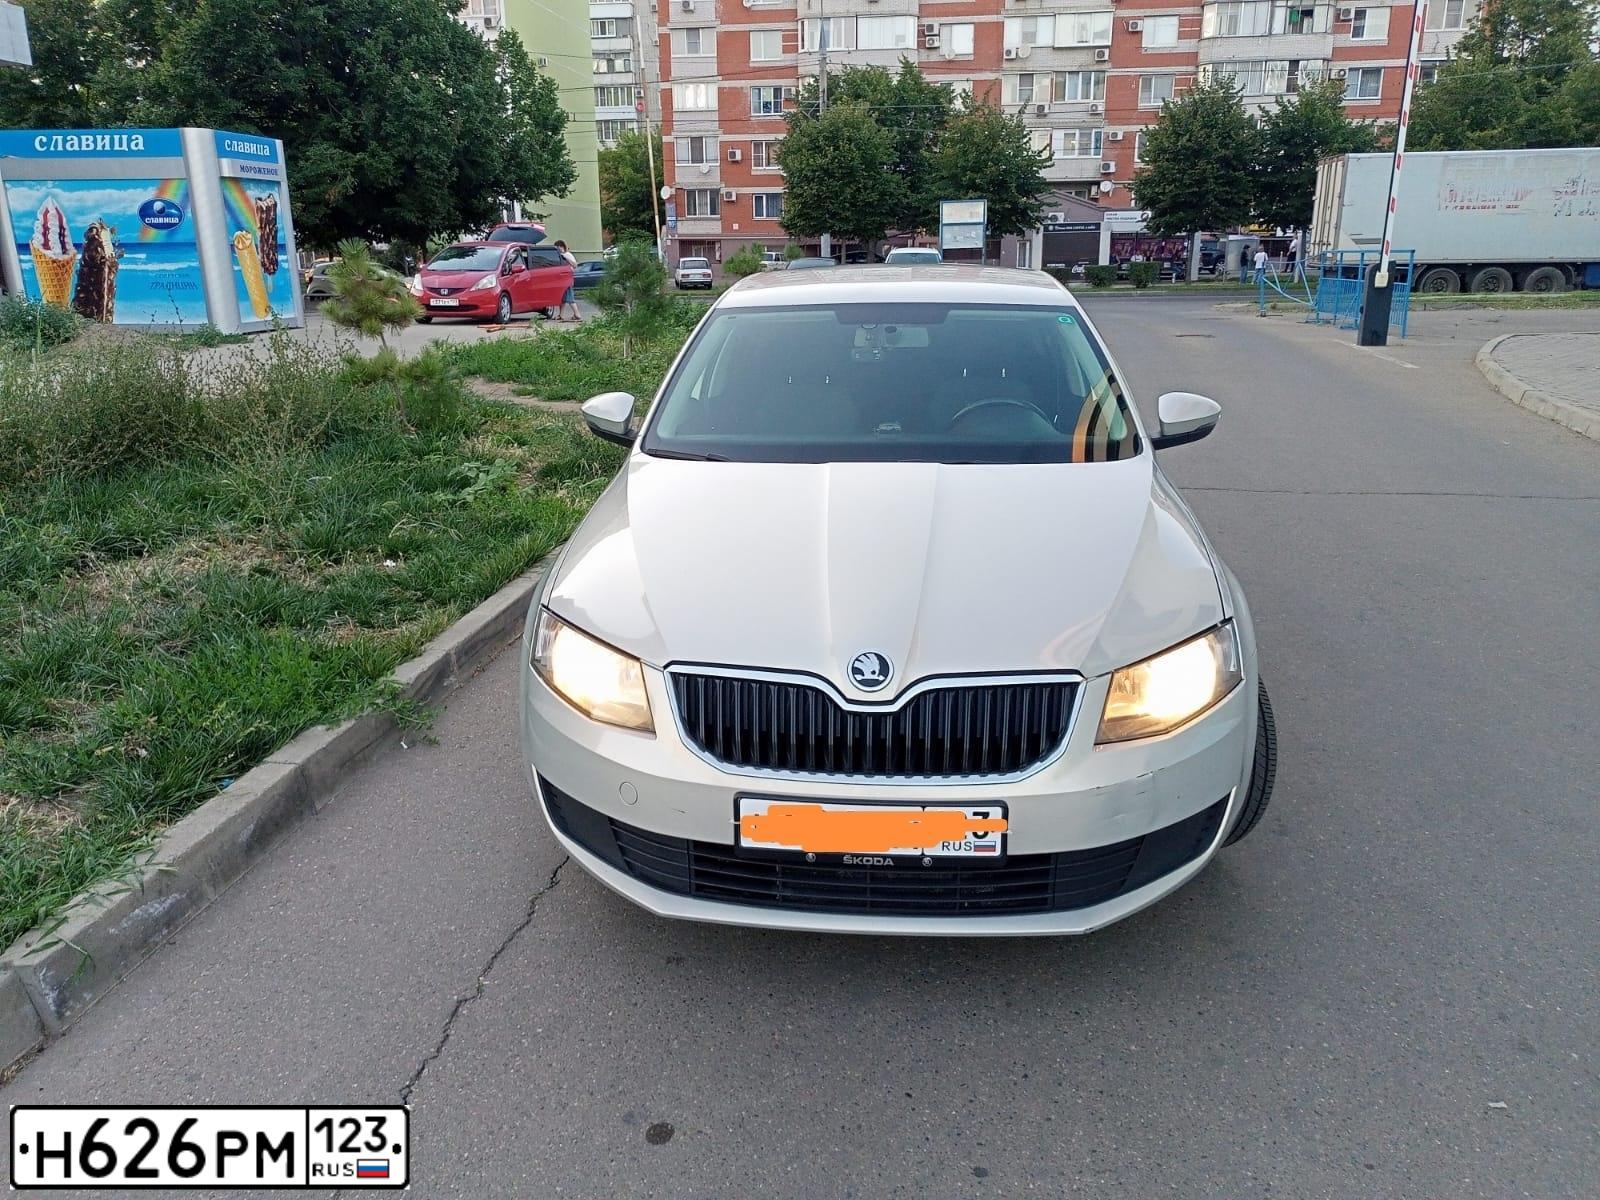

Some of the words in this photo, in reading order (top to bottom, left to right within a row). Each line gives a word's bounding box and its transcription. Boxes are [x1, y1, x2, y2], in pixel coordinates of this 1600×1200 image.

[34, 133, 145, 151] славица
[225, 139, 270, 156] славица
[942, 841, 973, 852] RUS
[843, 855, 895, 866] ŠKODA
